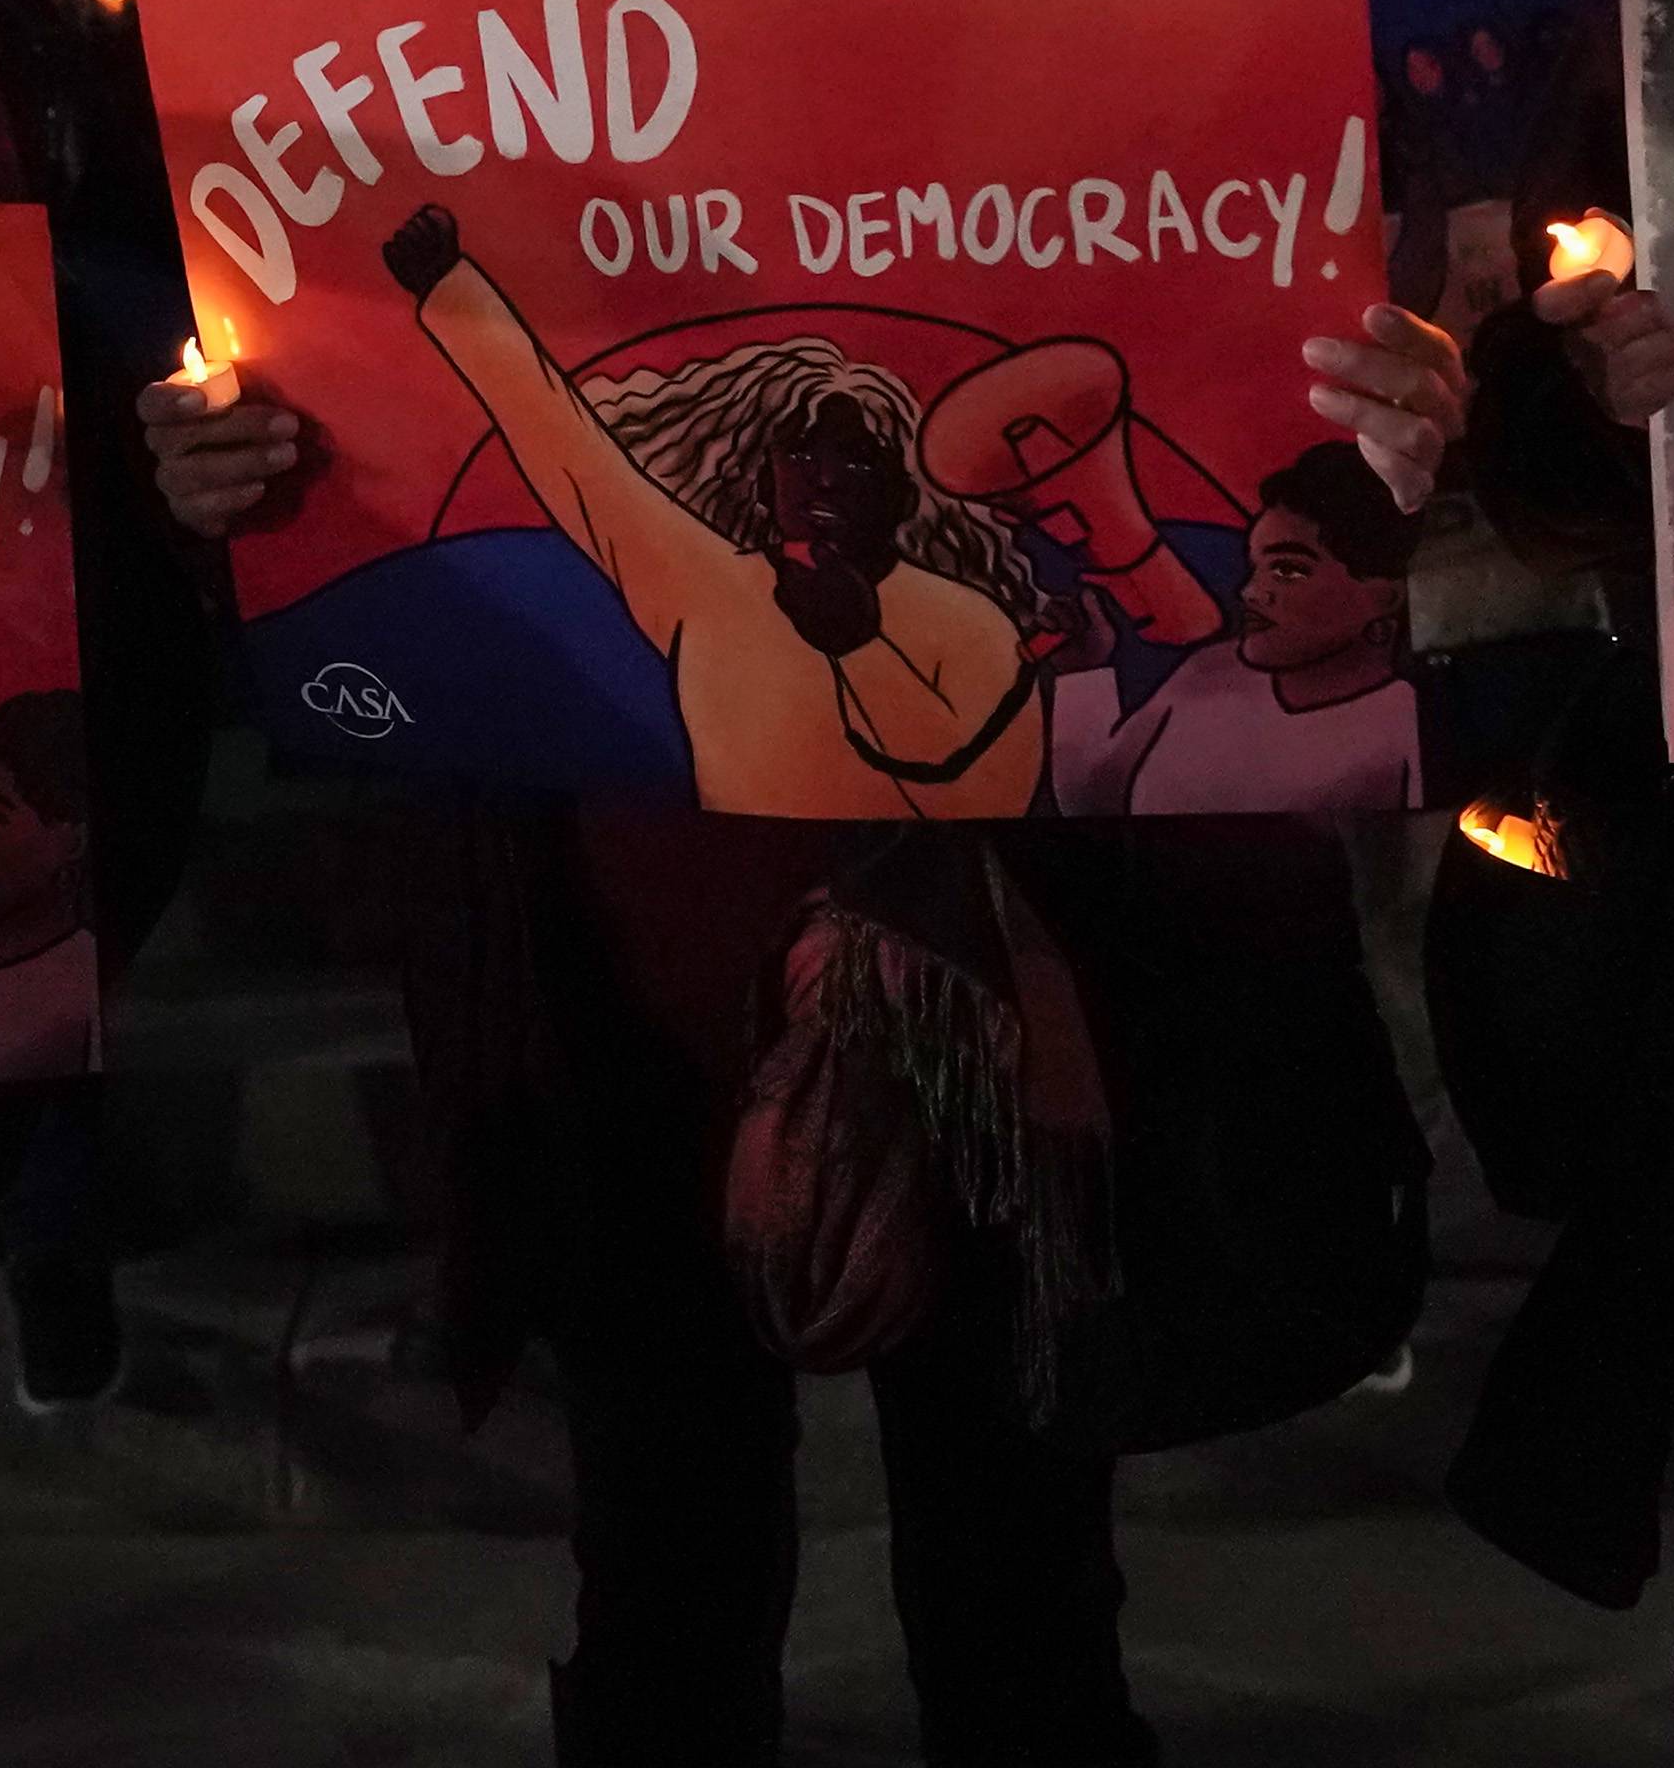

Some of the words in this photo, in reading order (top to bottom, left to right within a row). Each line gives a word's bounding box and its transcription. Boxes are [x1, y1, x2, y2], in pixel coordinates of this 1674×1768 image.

[577, 187, 759, 278] OUR
[788, 115, 1366, 288] DEMOCRACY!
[300, 680, 417, 724] CASA
